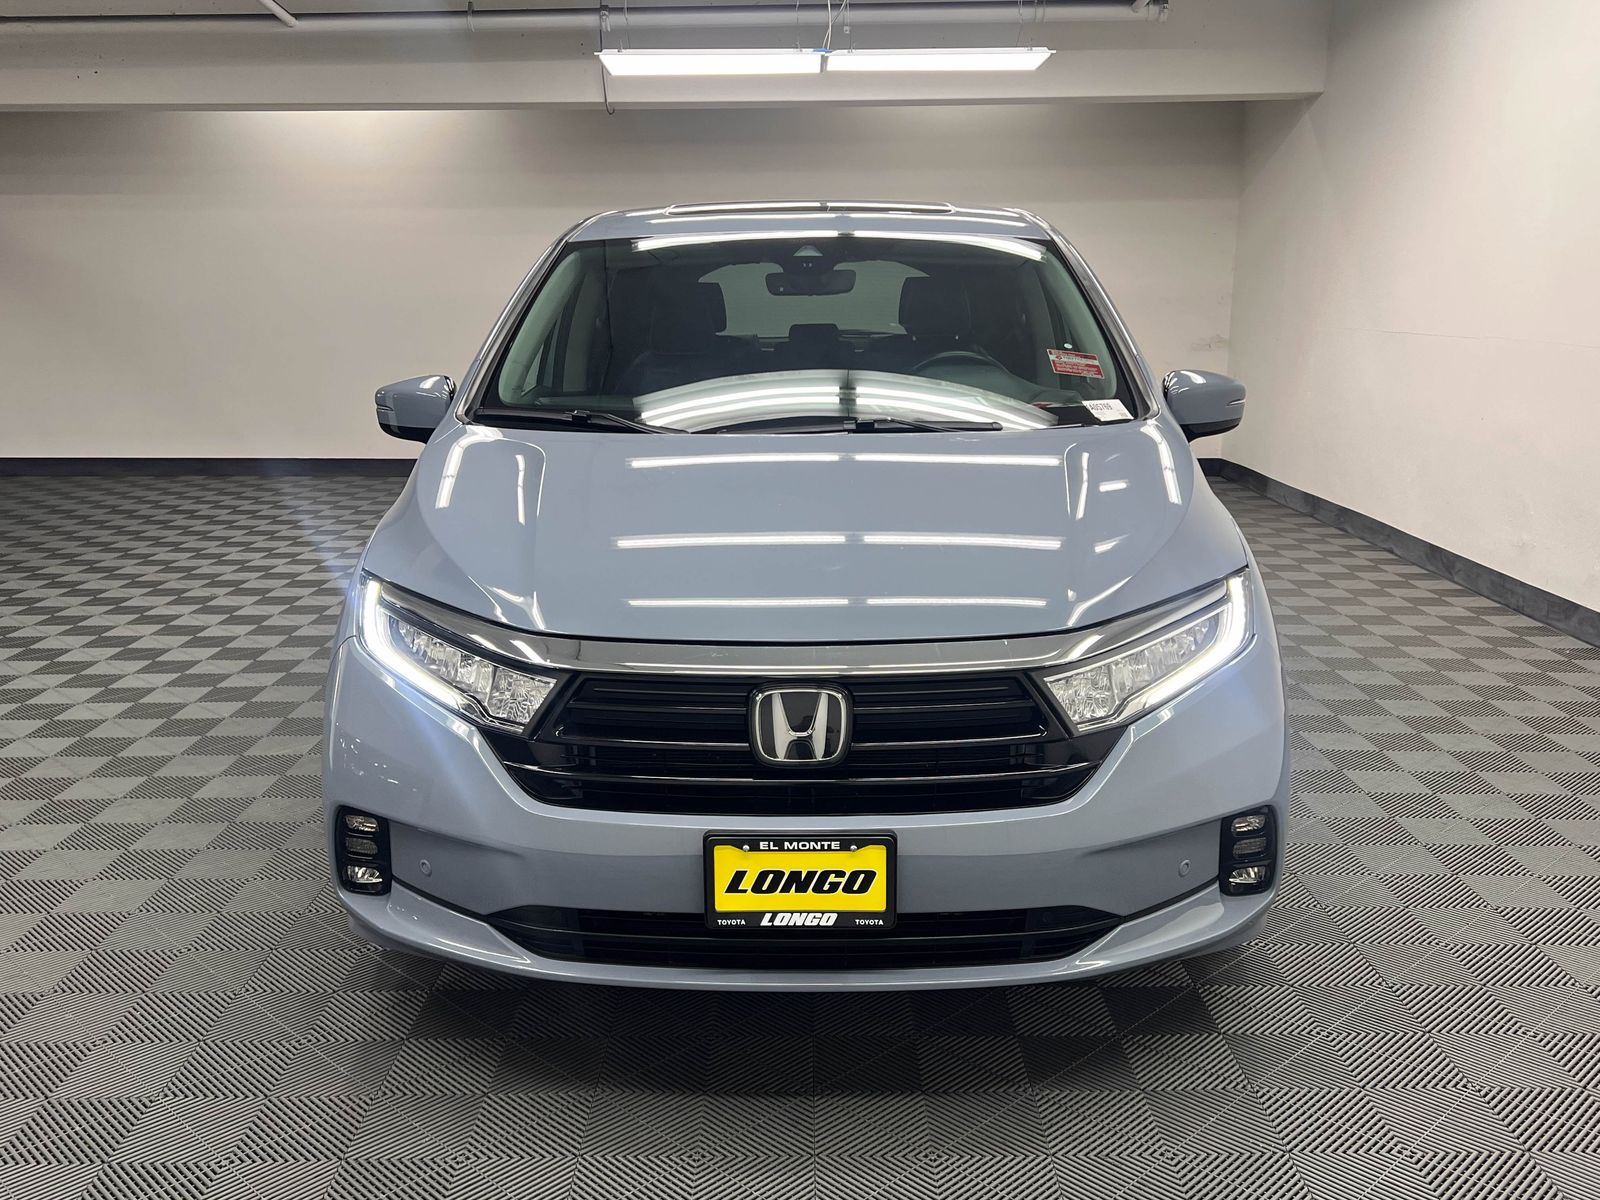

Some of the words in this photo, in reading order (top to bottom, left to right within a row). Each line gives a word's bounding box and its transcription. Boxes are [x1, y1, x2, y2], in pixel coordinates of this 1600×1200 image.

[759, 841, 779, 850] EL
[784, 841, 841, 850] MONTE
[724, 869, 877, 895] LONGO
[760, 912, 838, 927] LONGO
